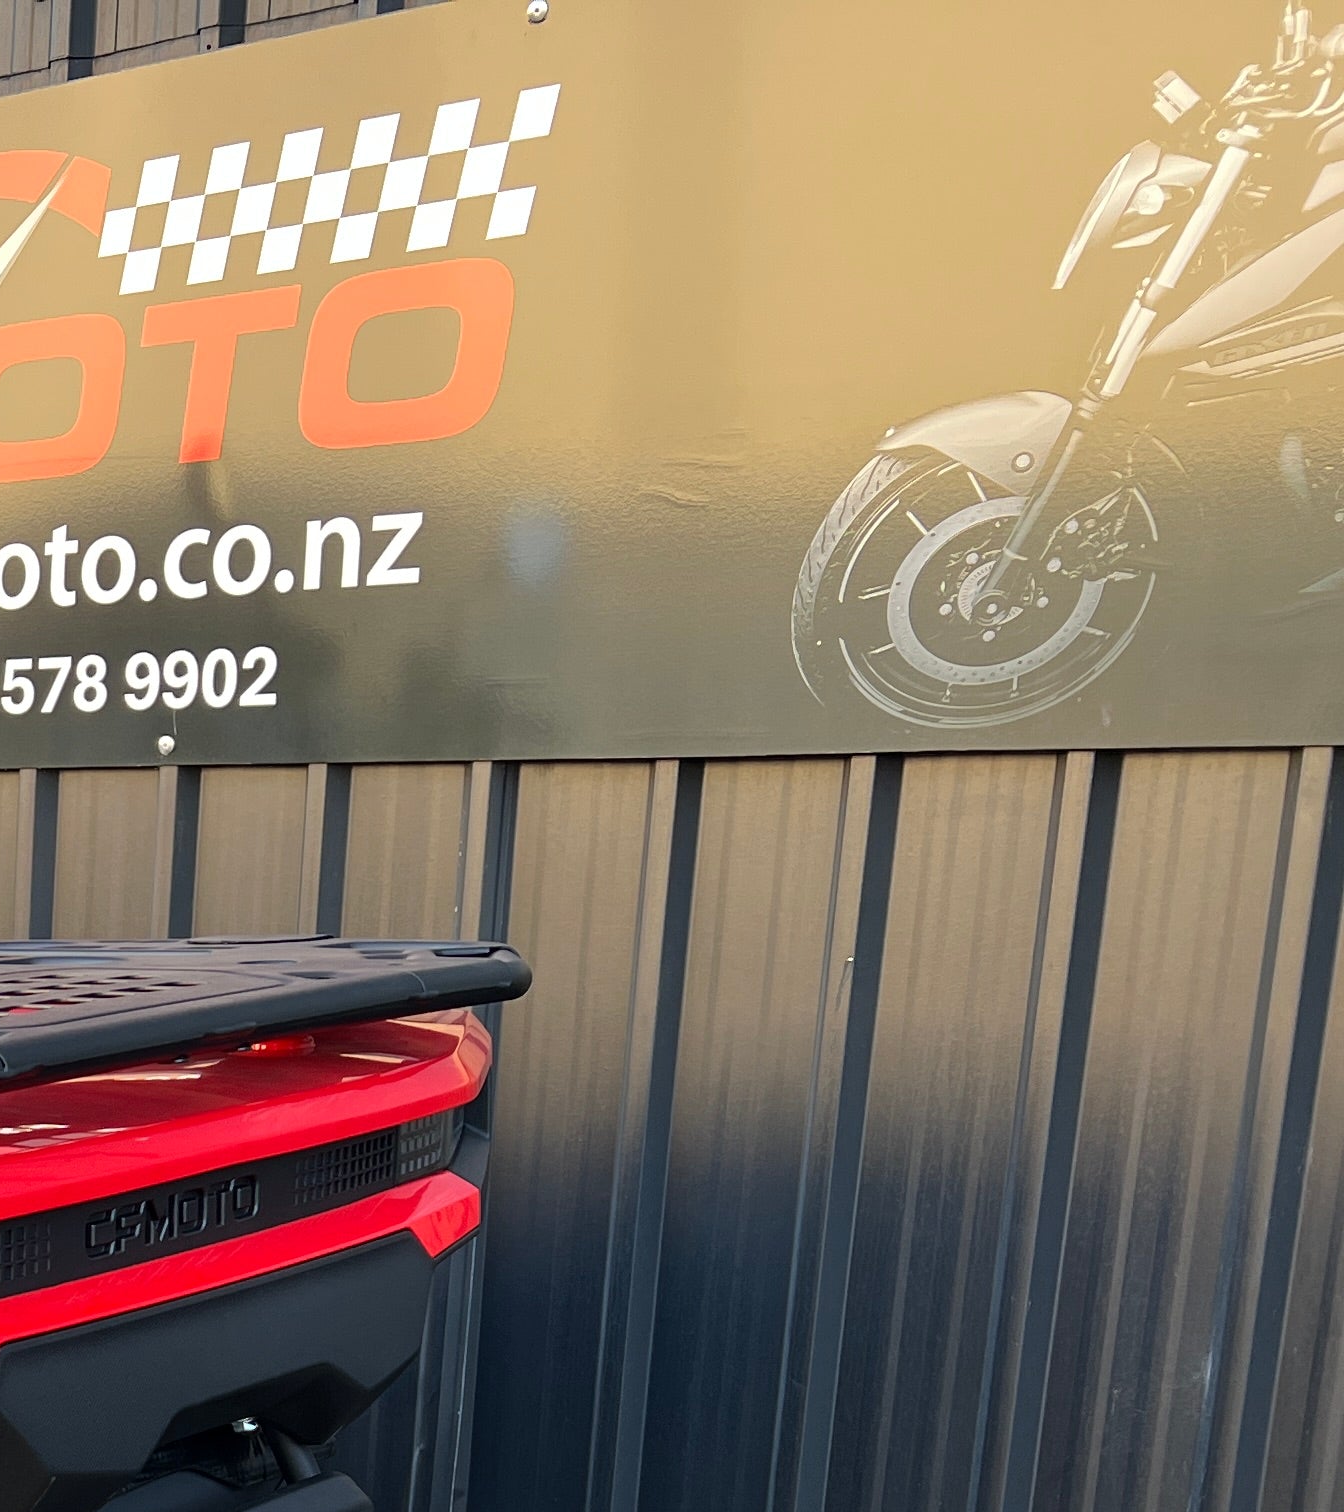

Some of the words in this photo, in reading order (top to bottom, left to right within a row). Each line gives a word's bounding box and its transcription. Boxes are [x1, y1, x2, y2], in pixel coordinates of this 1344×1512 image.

[0, 654, 108, 715] 578
[124, 646, 277, 711] 9902
[85, 1175, 260, 1259] CFMOTO
